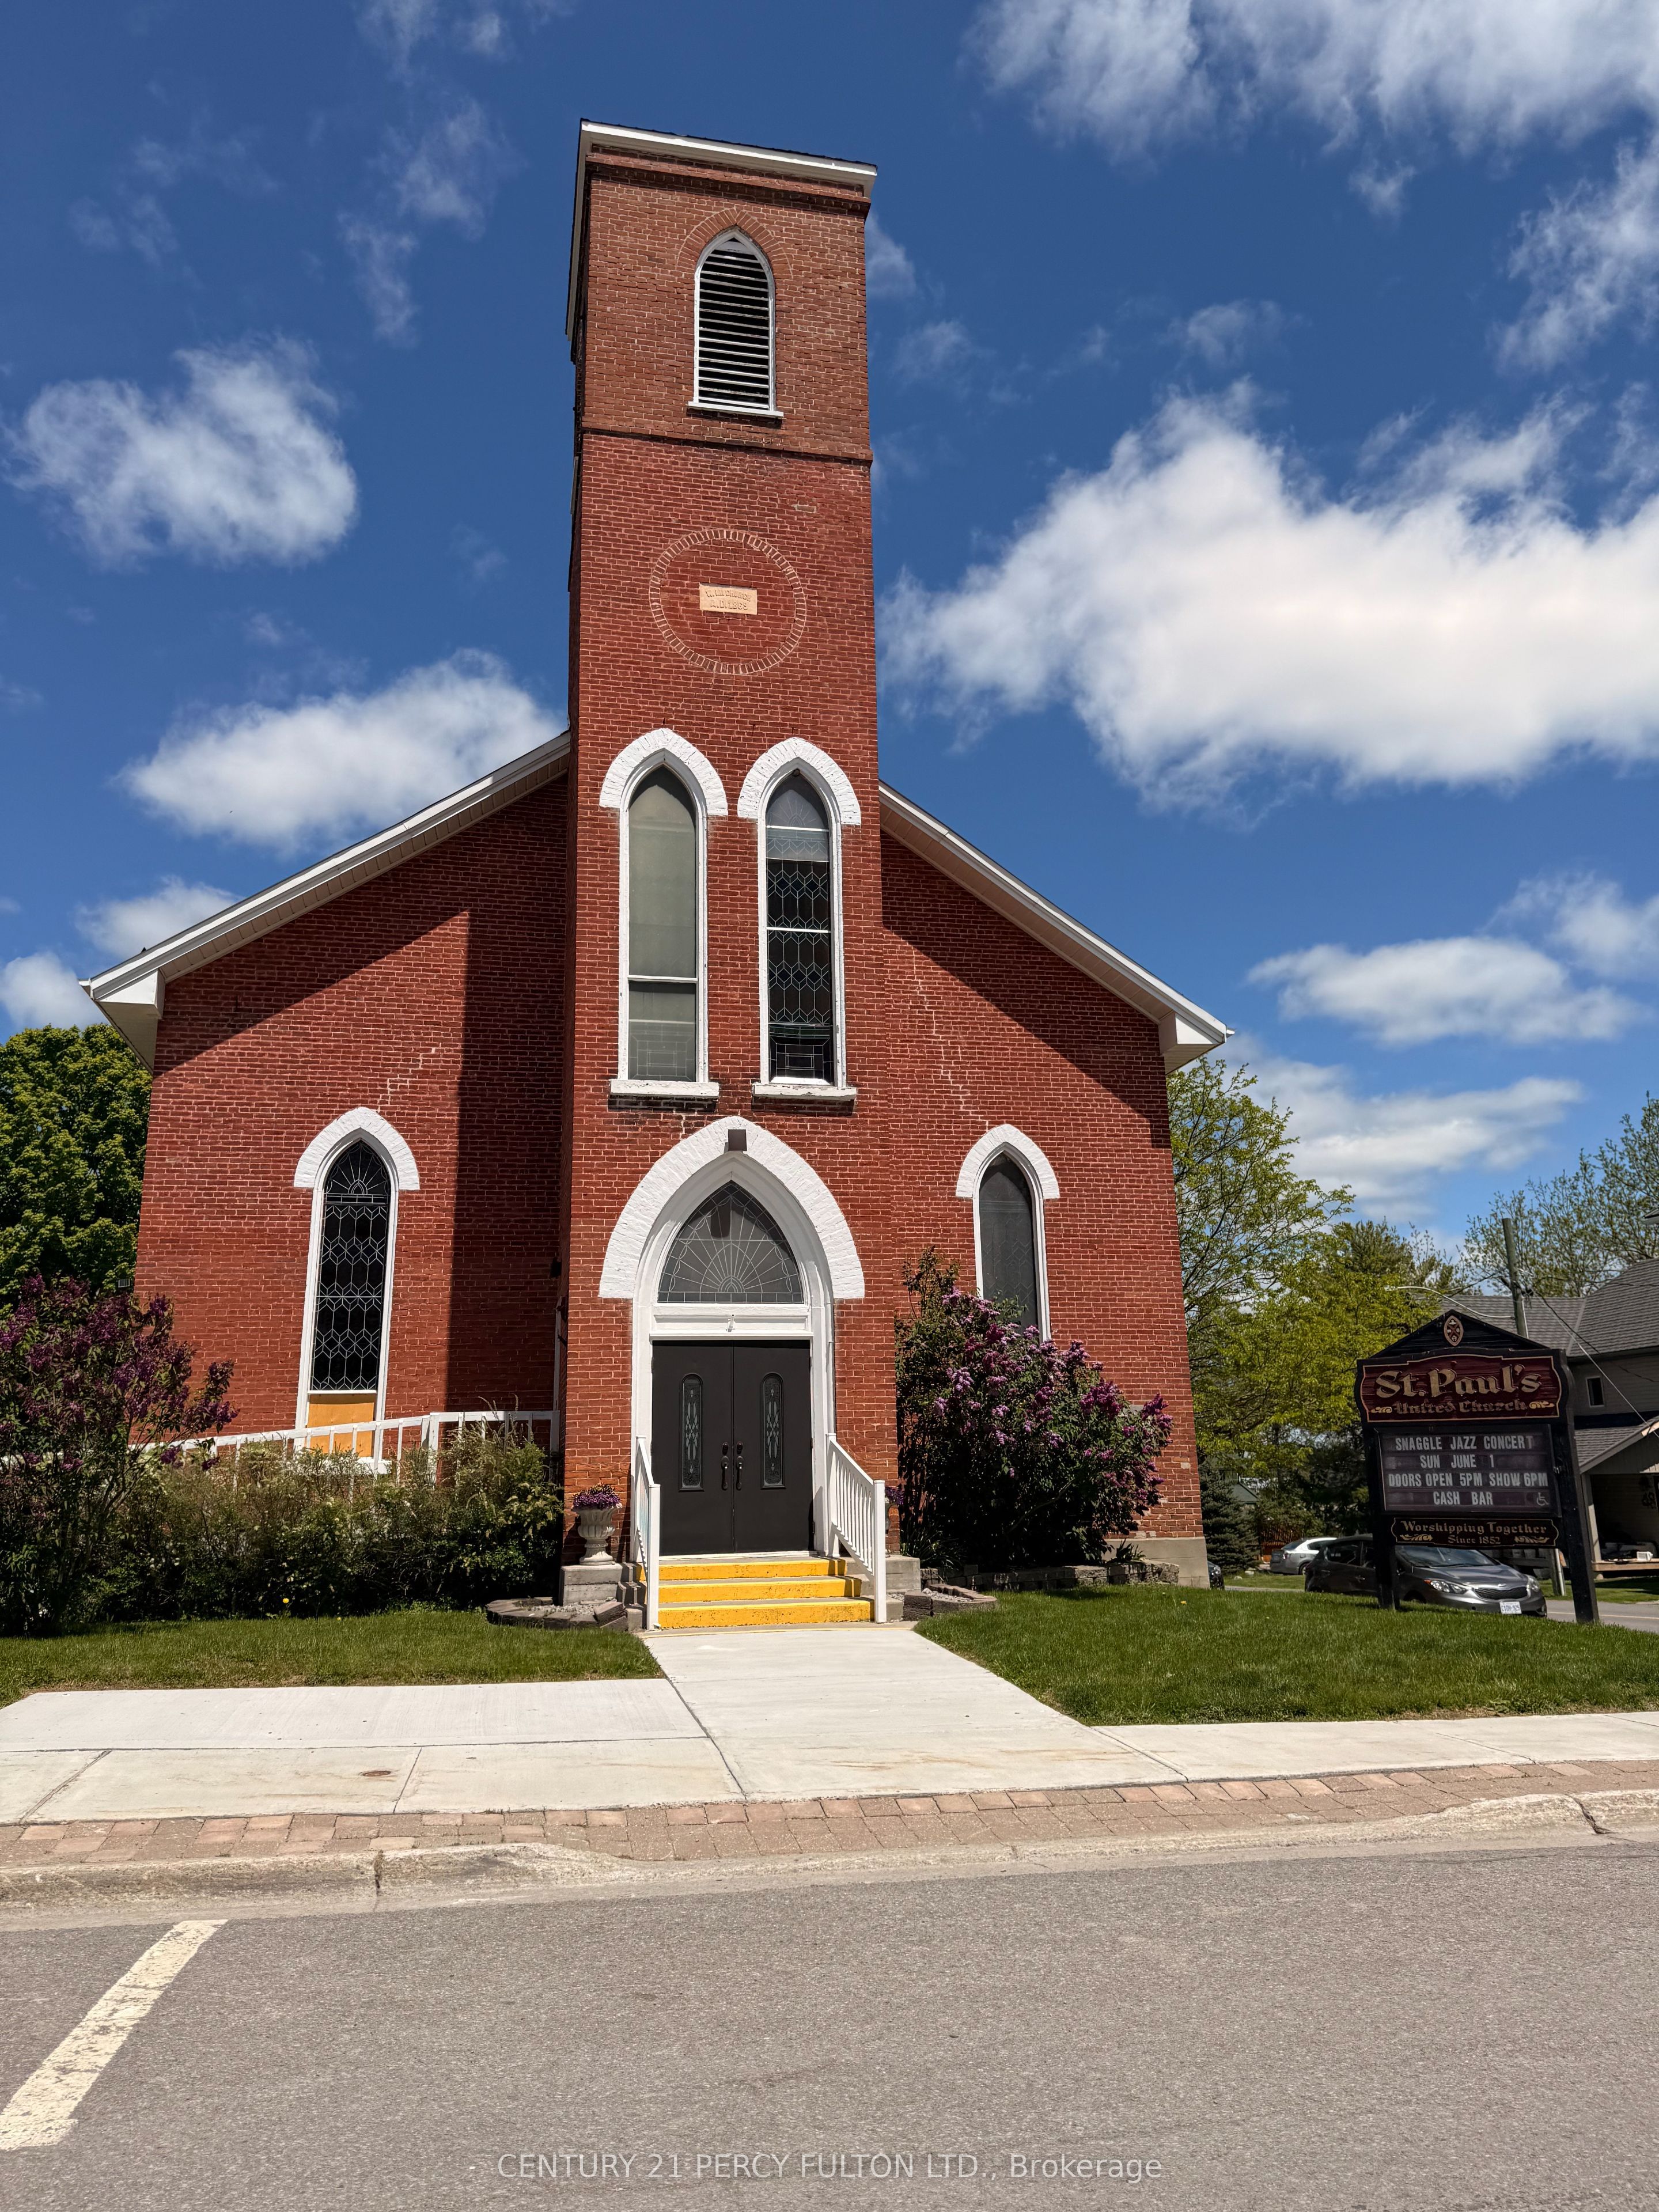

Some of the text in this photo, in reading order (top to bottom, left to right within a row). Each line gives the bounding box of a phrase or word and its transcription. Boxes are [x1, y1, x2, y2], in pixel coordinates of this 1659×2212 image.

[1395, 1398, 1527, 1414] United Church
[1395, 1435, 1533, 1450] SNAGGLE JAZZ CONCERT
[1419, 1454, 1495, 1468] SUN JUNE 1
[1388, 1472, 1548, 1487] DOORS OPEN 5PM SHOW 6PM
[1433, 1491, 1494, 1505] CASH BAR
[1400, 1520, 1547, 1535] Worshipping Together
[1448, 1535, 1501, 1545] Since 1852
